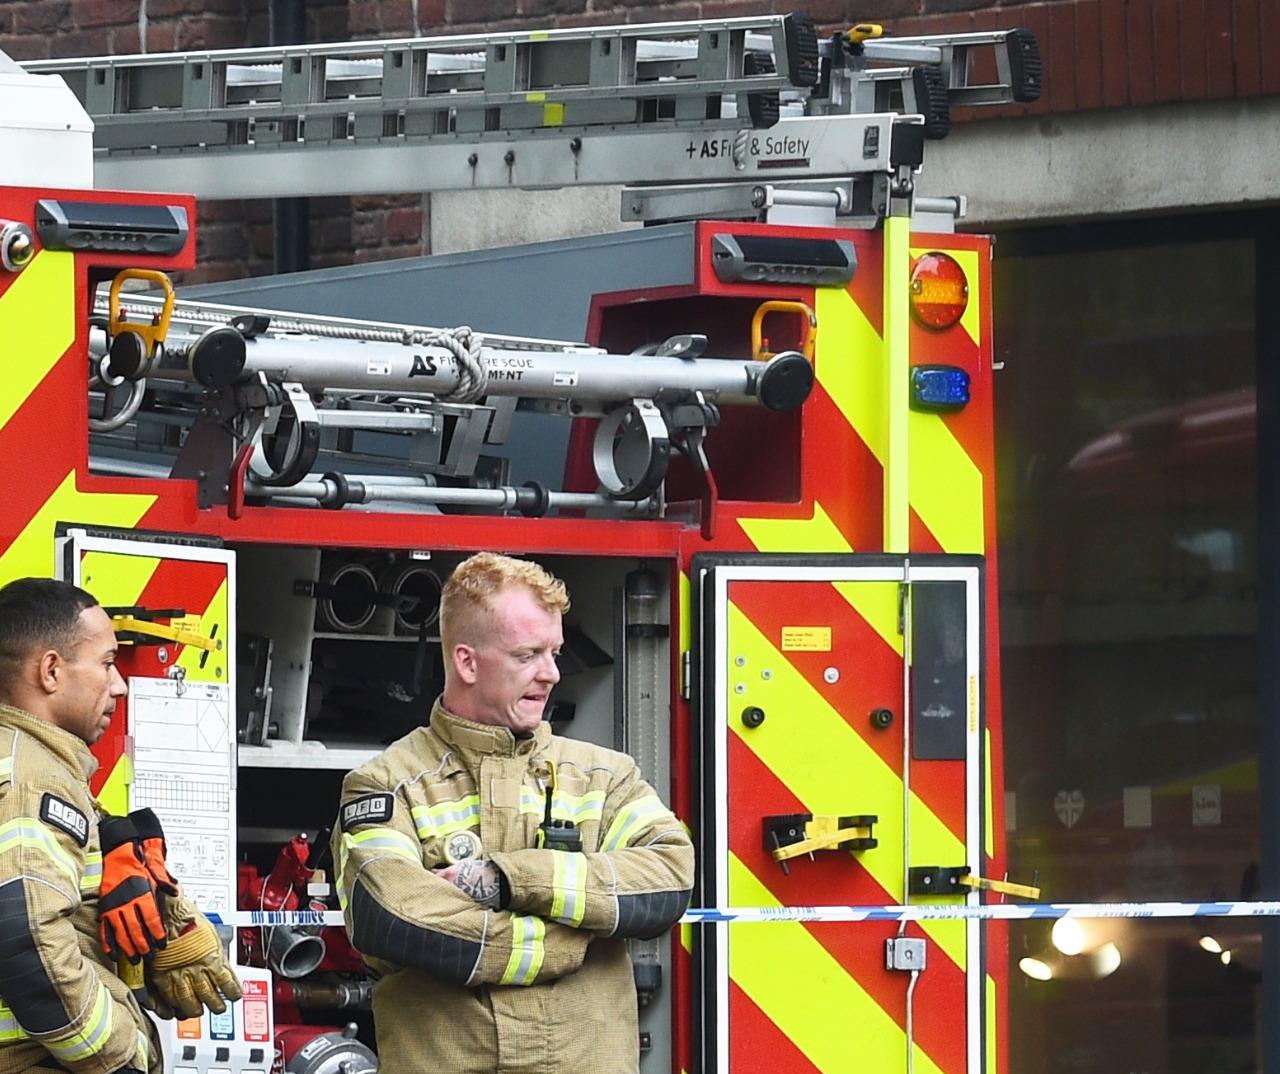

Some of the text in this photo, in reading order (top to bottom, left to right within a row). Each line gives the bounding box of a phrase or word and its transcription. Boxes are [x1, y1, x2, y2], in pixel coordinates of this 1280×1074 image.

[700, 141, 718, 158] AS
[750, 138, 761, 156] &
[766, 136, 810, 156] Safety
[408, 355, 437, 378] AS
[51, 800, 85, 832] LFB
[346, 799, 383, 818] LFB
